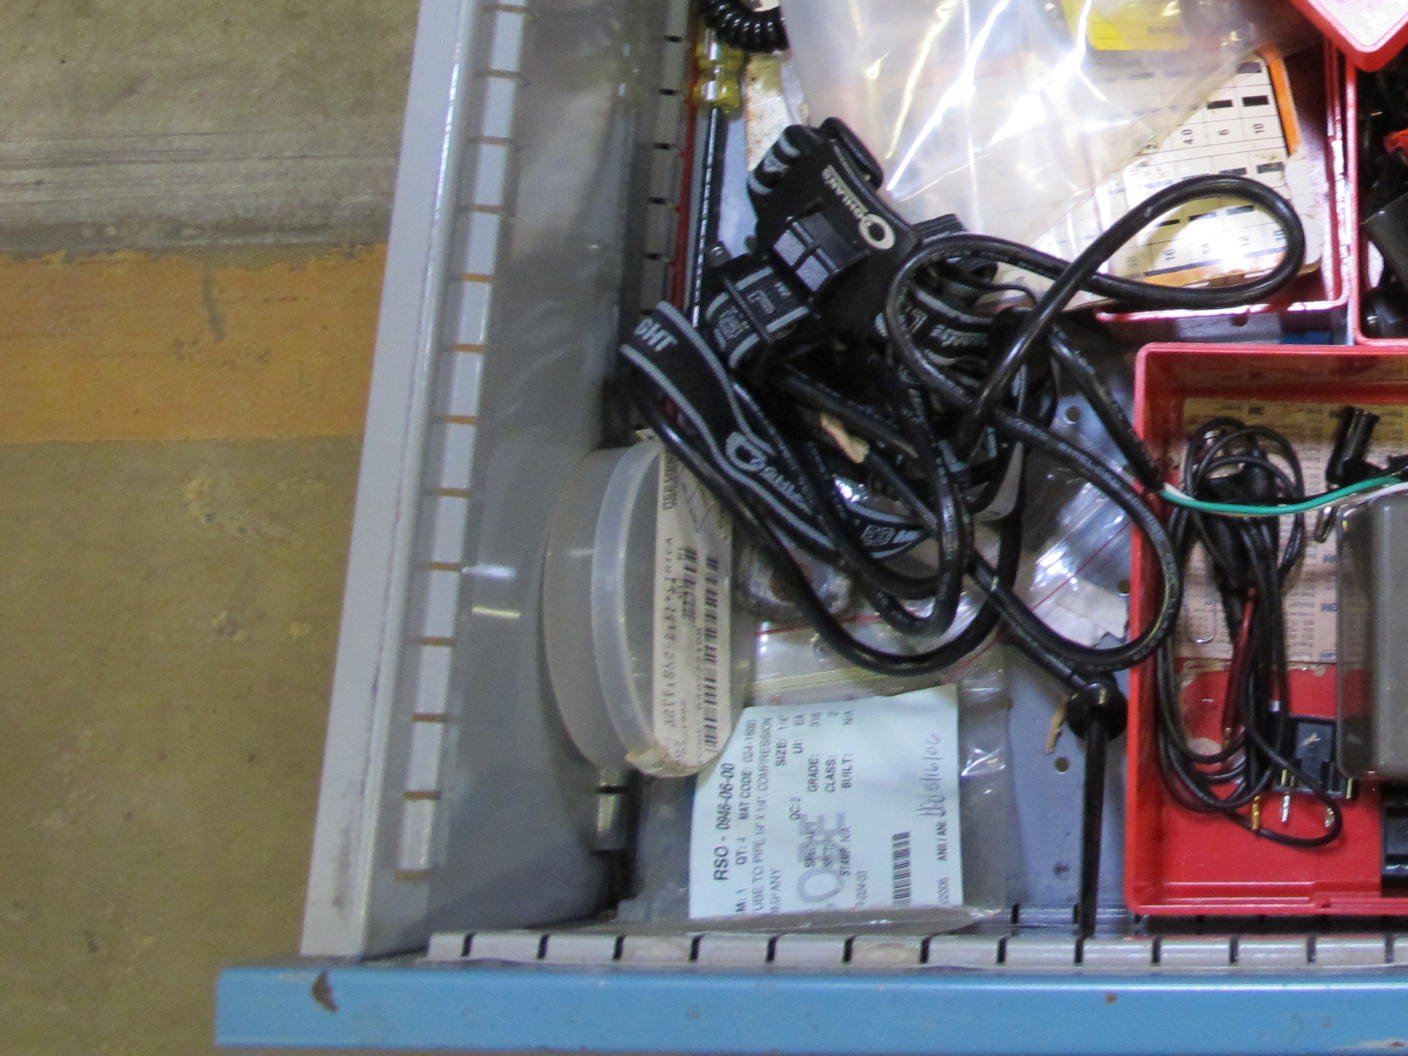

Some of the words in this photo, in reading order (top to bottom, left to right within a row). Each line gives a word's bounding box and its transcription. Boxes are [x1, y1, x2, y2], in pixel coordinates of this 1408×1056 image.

[1251, 122, 1266, 135] 10
[808, 754, 820, 793] GRADE:
[823, 755, 837, 793] CLASS:
[712, 846, 730, 881] RSO
[753, 886, 765, 912] UBE
